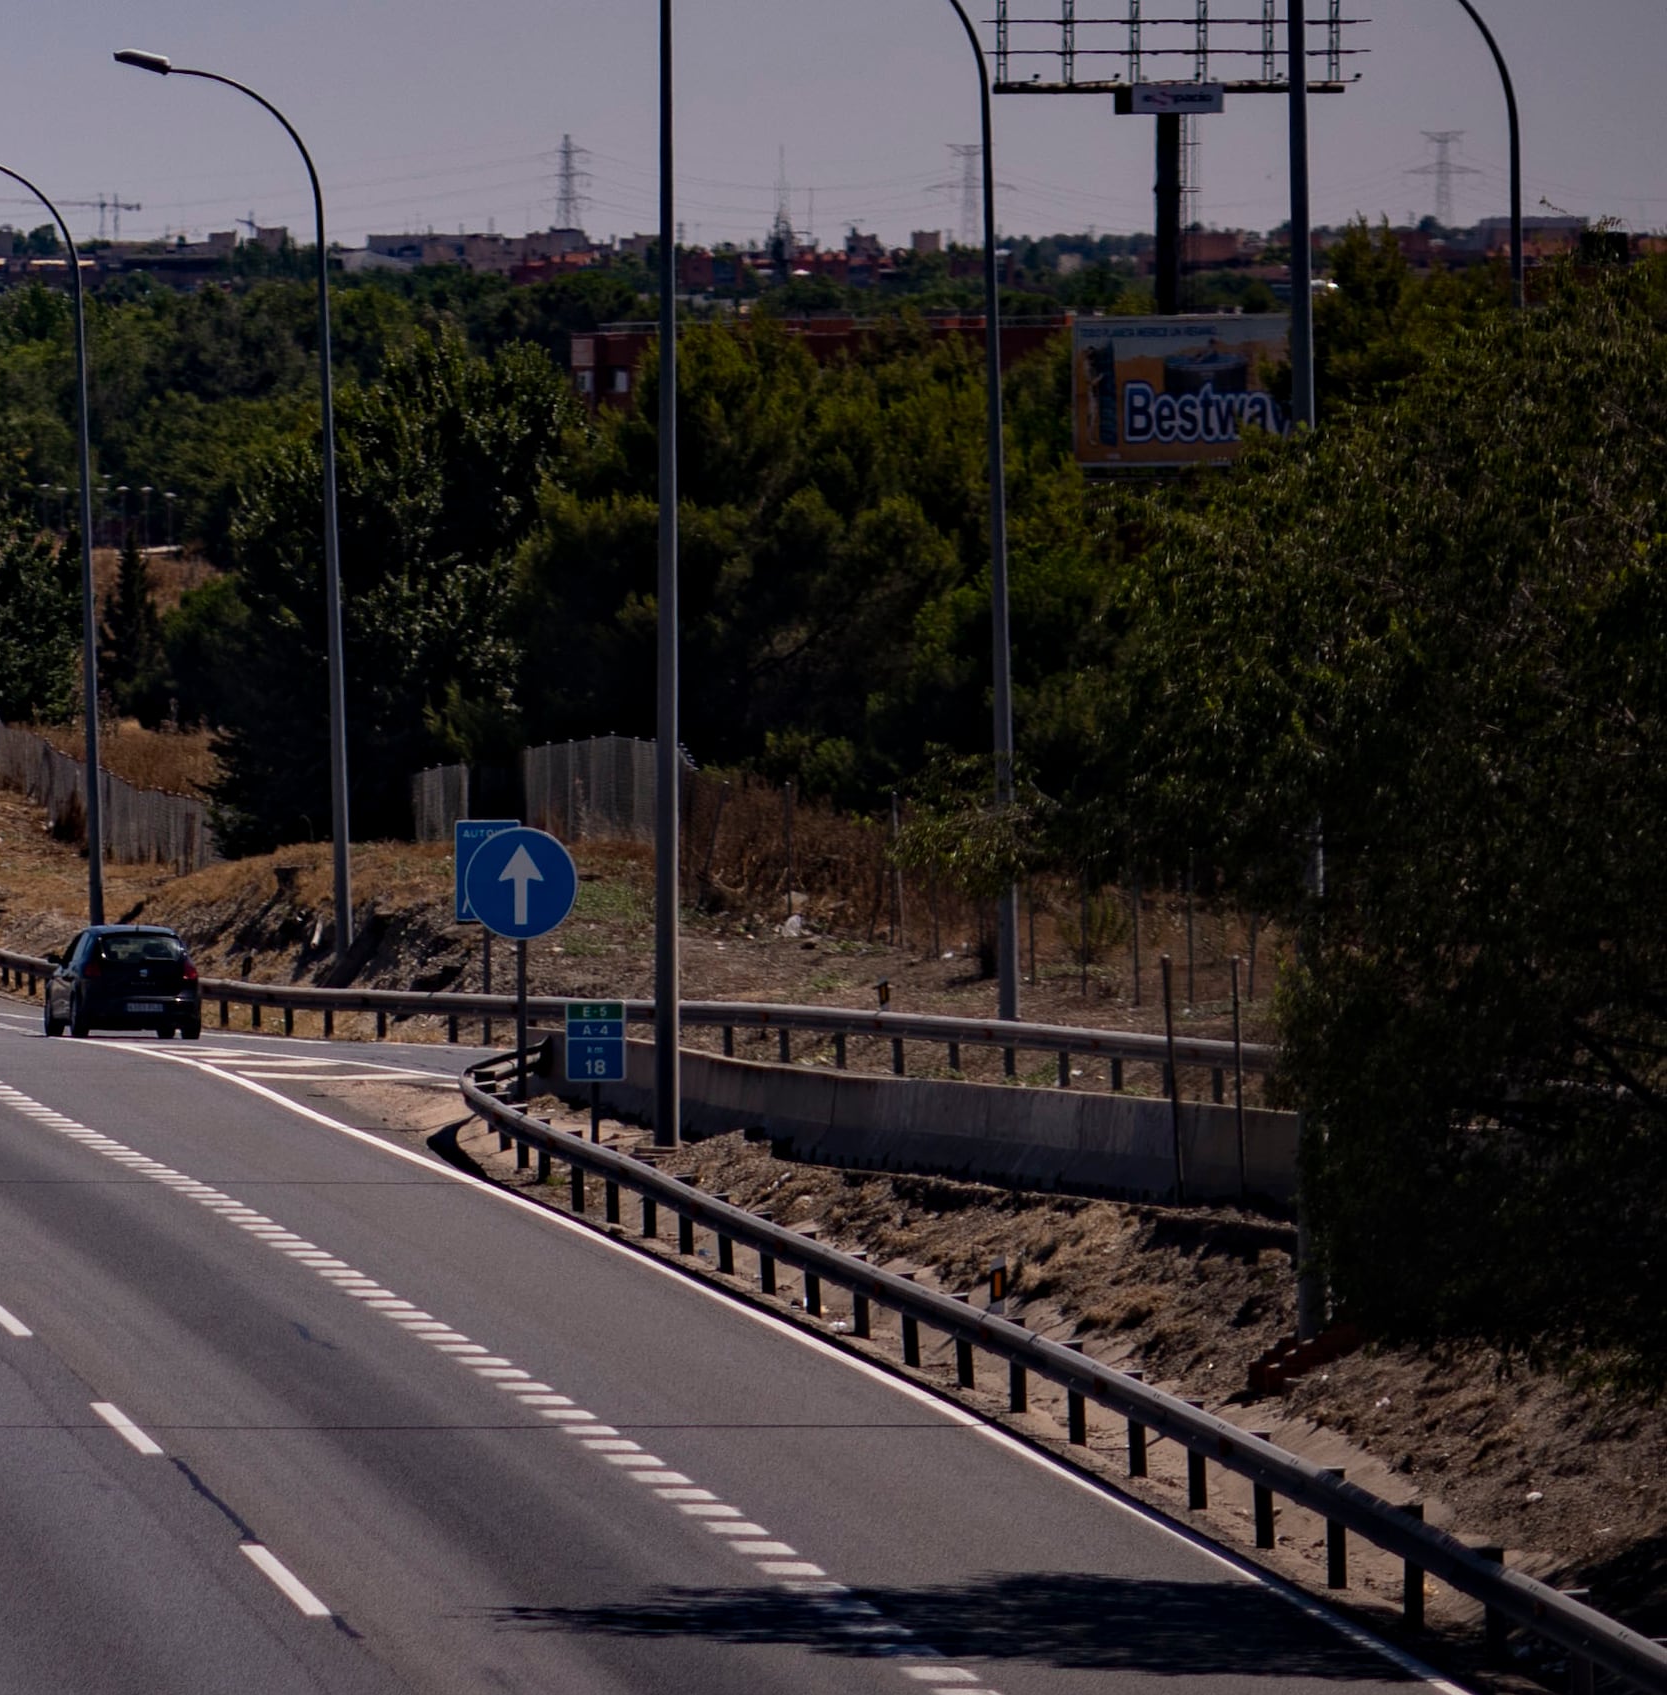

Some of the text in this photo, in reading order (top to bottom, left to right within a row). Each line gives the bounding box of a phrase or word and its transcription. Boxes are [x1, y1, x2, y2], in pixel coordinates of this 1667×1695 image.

[582, 1006, 608, 1017] E-5
[582, 1024, 609, 1036] A-4
[584, 1059, 607, 1076] 18
